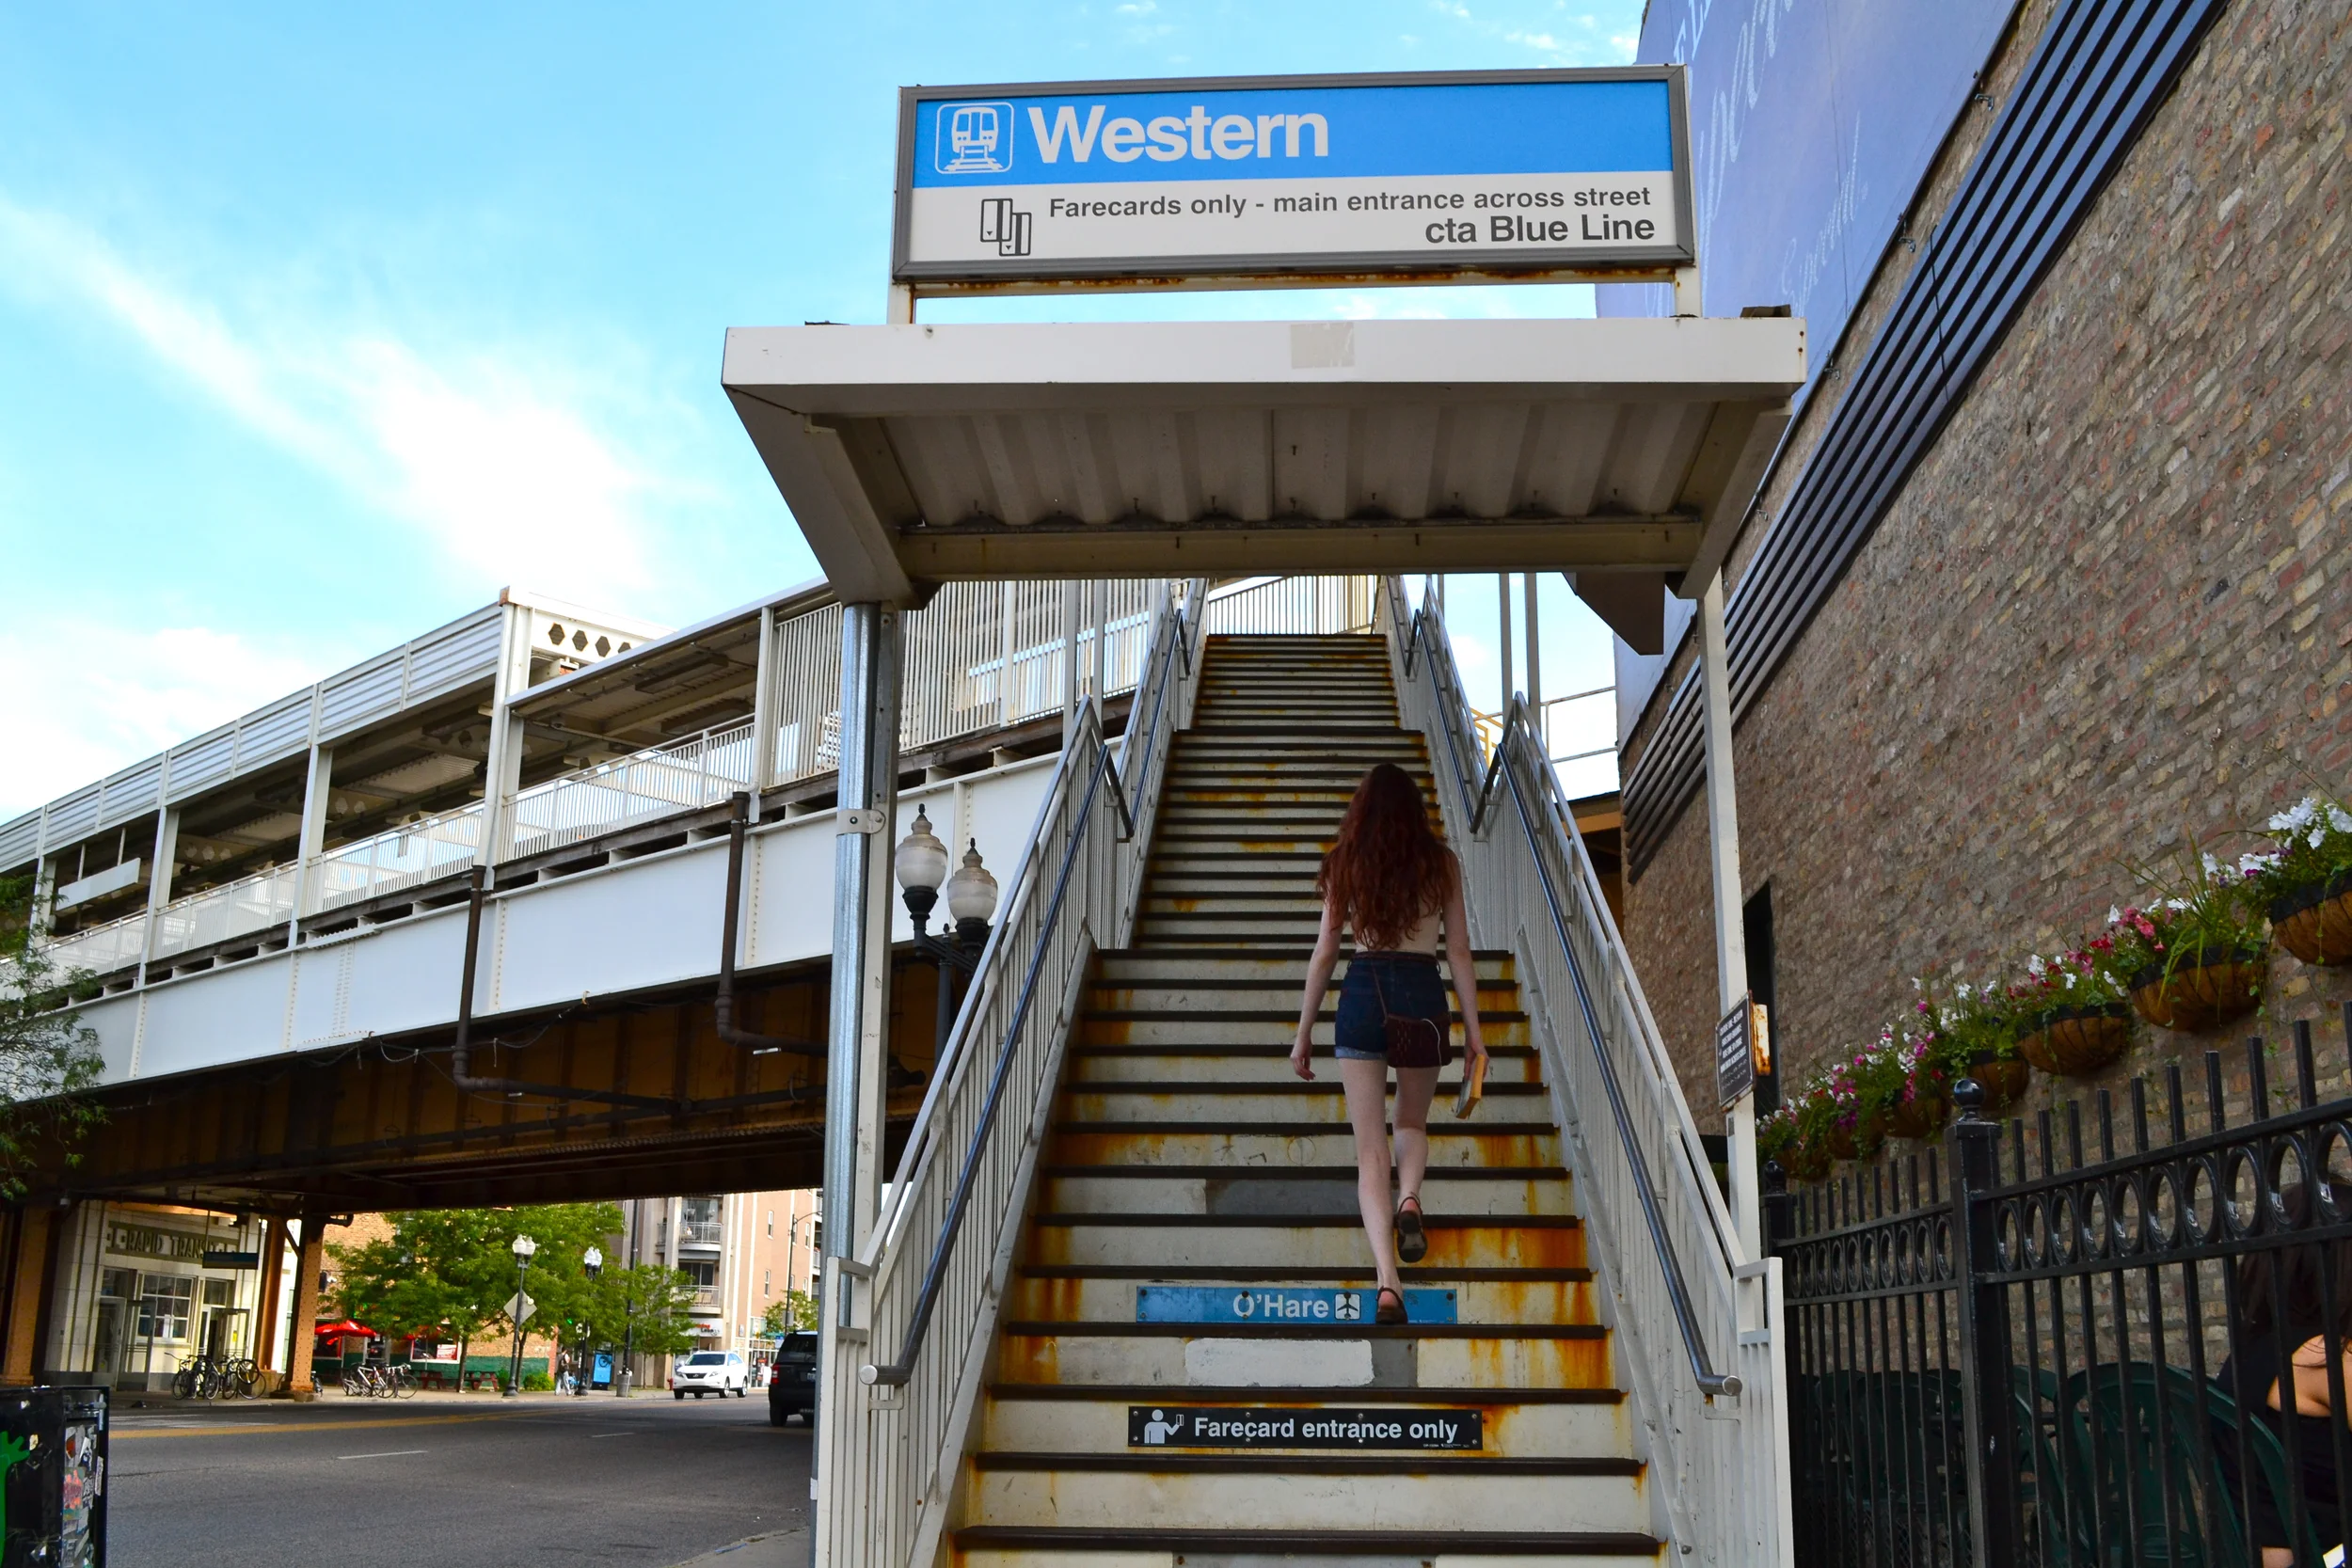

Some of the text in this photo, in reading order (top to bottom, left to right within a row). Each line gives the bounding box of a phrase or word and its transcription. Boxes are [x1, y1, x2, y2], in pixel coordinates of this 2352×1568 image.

[1027, 104, 1328, 164] Western
[1050, 196, 1182, 217] Farecards
[1190, 194, 1247, 218] only
[1273, 193, 1338, 213] main
[1347, 191, 1465, 212] entrance
[1473, 190, 1565, 209] across
[1573, 186, 1651, 207] street
[1424, 213, 1655, 244] cta Blue Line
[127, 1229, 163, 1254] RAPID
[1232, 1293, 1329, 1319] O'Hare
[1194, 1417, 1458, 1444] Farecard entrance only
